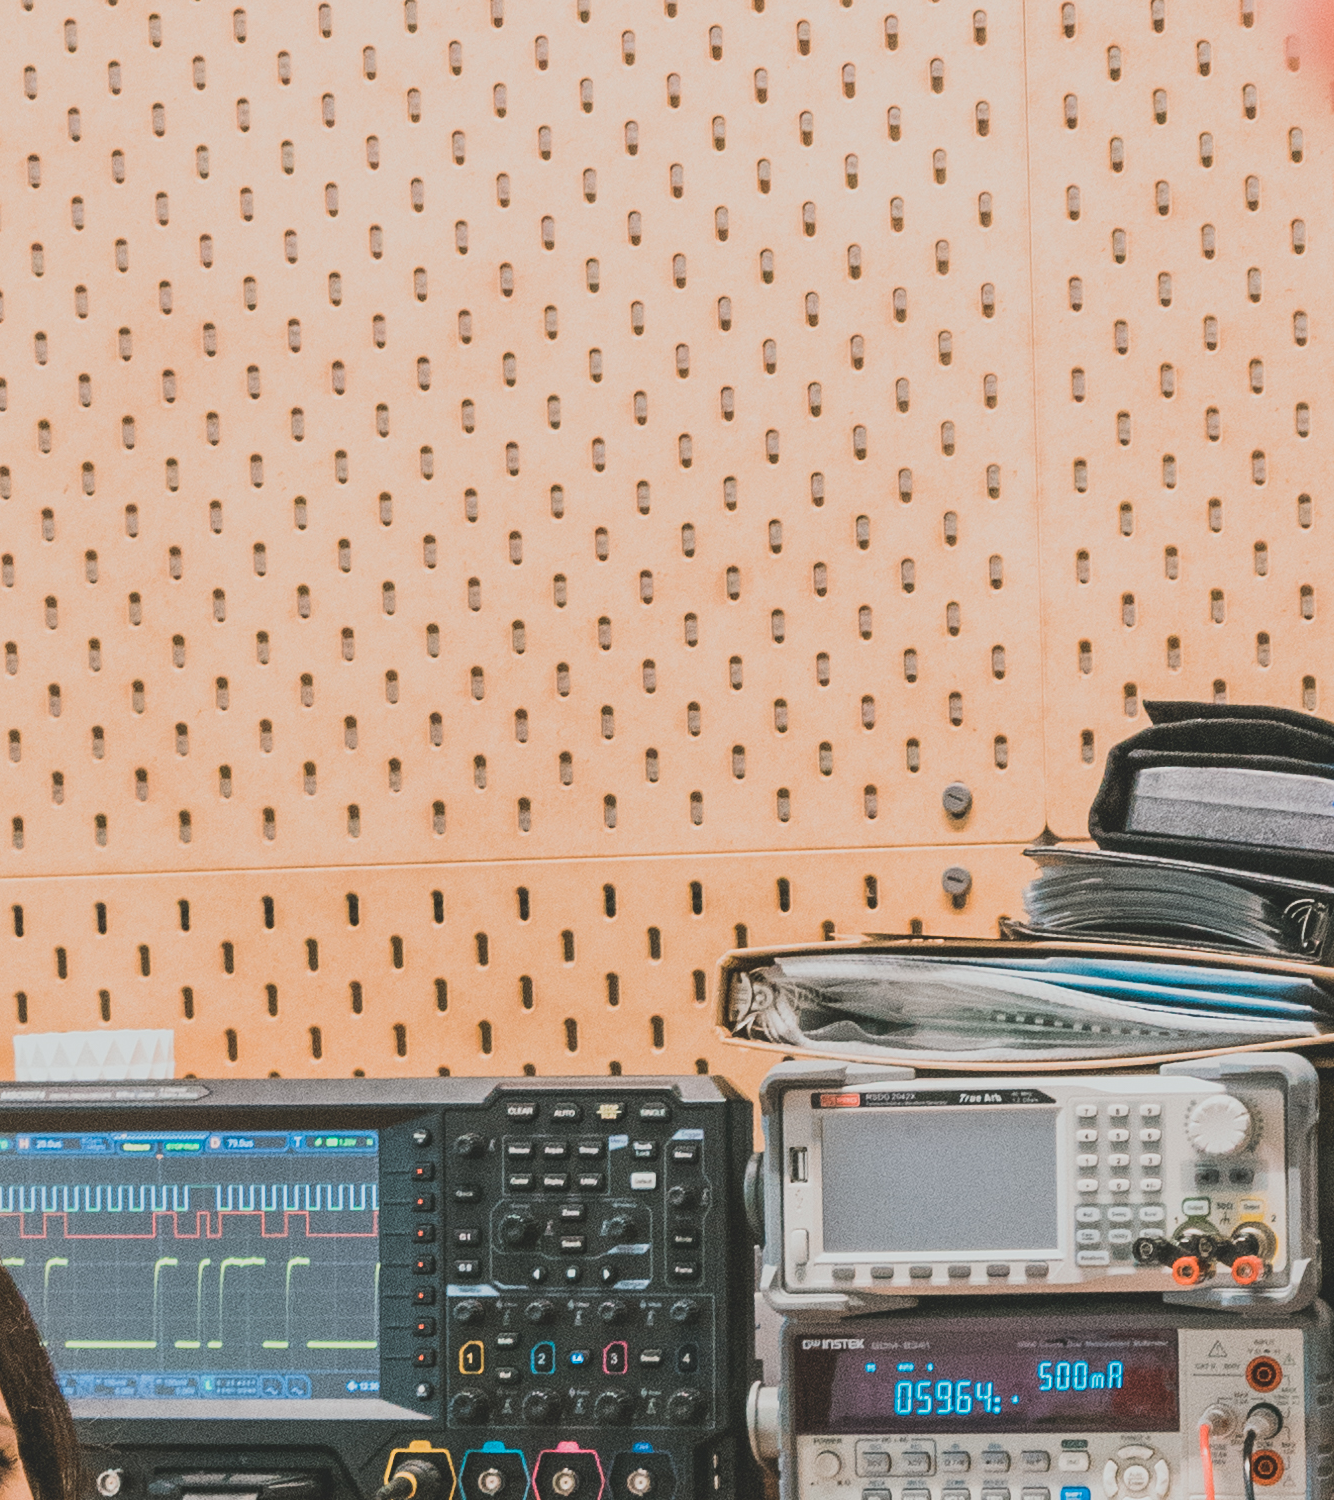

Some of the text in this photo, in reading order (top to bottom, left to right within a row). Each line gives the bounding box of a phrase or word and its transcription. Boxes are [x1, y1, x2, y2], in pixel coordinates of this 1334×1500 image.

[958, 1093, 982, 1104] True
[984, 1092, 1003, 1103] Arb
[507, 1106, 534, 1116] CLEAR
[554, 1109, 576, 1118] AUTO
[1271, 1214, 1277, 1223] 2
[822, 1338, 865, 1350] INSTEK
[466, 1352, 474, 1364] 1
[537, 1353, 547, 1364] 2
[610, 1353, 619, 1364] 3
[682, 1353, 691, 1364] 4
[1037, 1360, 1125, 1392] 500mA
